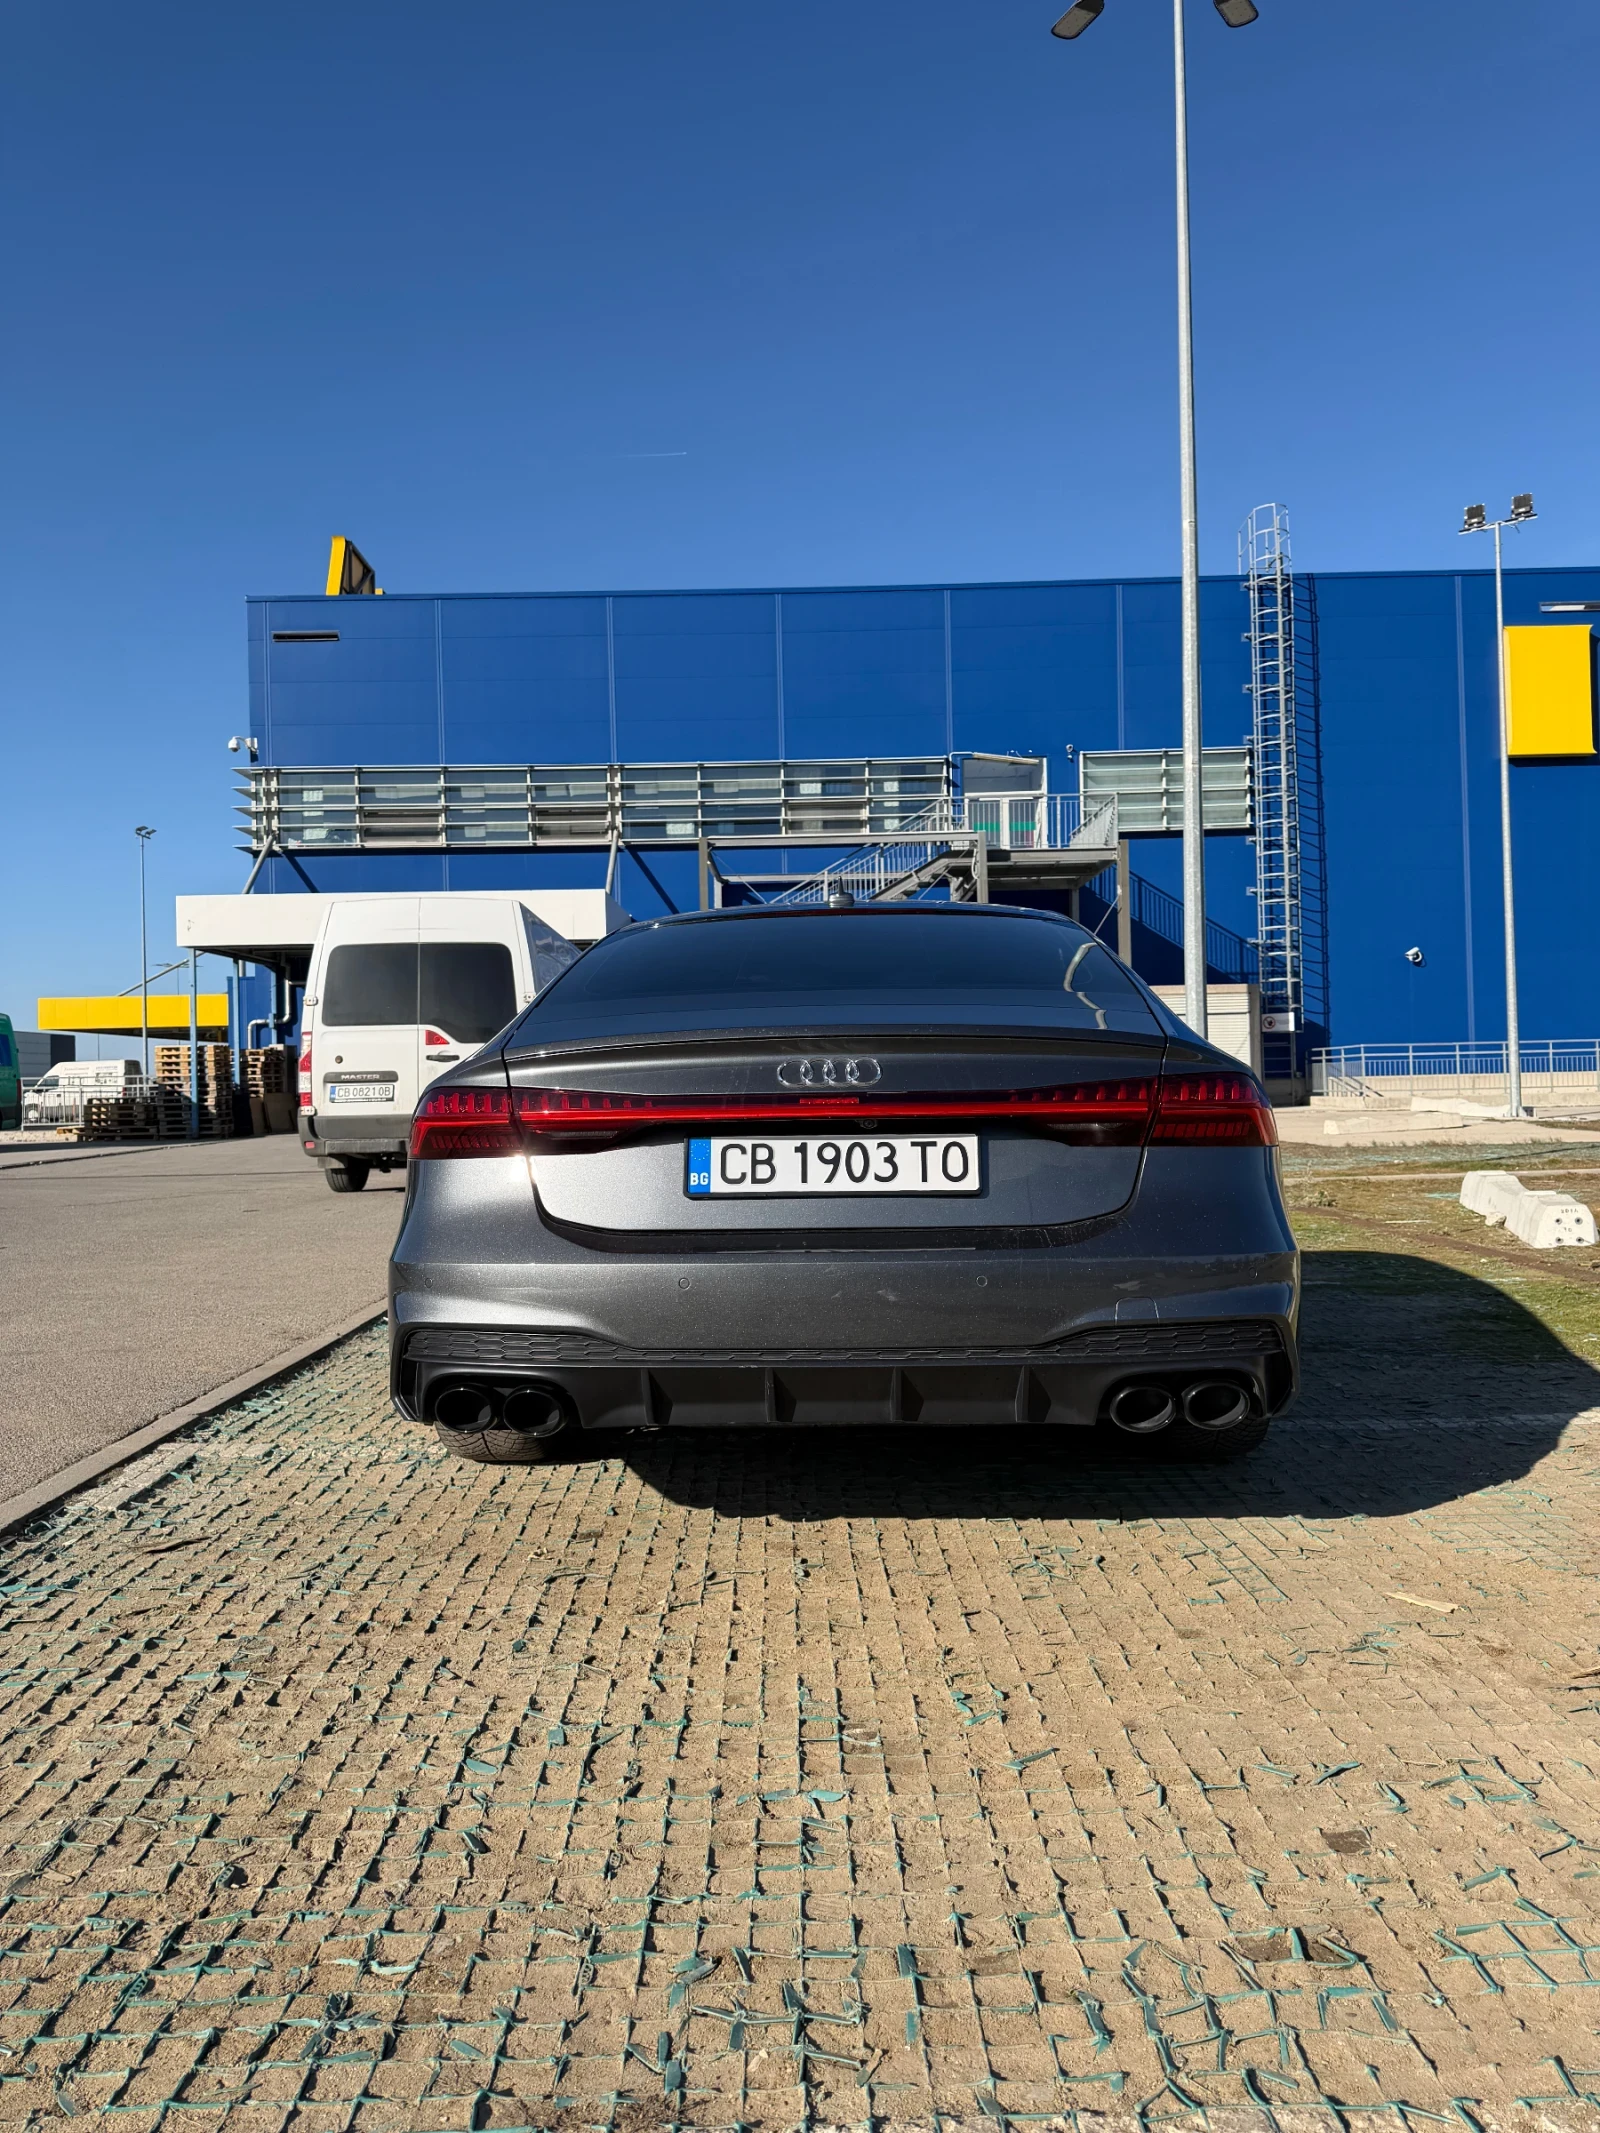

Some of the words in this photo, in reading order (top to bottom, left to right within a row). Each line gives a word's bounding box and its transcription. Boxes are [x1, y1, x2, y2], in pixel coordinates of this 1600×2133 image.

[337, 1087, 350, 1098] CB
[352, 1086, 377, 1097] 0821
[720, 1143, 777, 1185] CB
[794, 1141, 899, 1184] 1903
[910, 1140, 969, 1183] TO
[689, 1172, 709, 1187] BG
